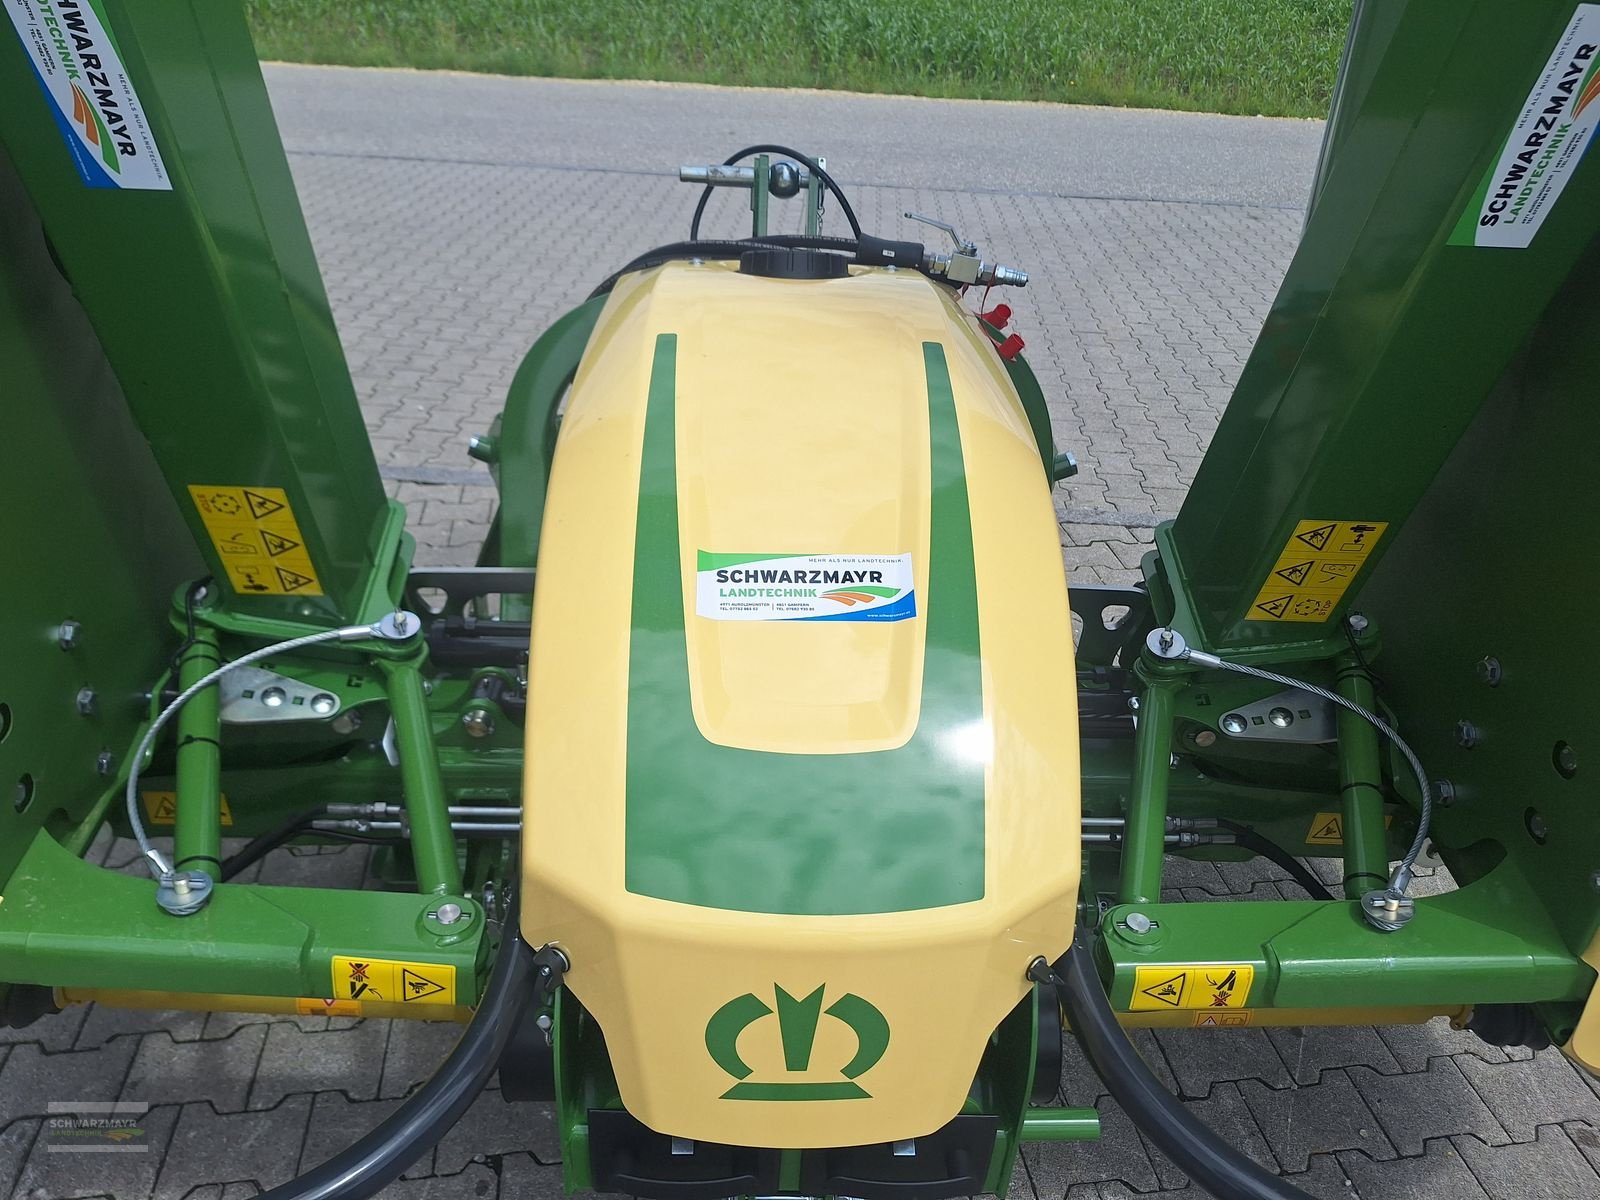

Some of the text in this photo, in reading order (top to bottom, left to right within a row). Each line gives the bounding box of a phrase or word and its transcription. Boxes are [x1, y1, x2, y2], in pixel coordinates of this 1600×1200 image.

[118, 73, 131, 95] MEHR
[127, 97, 137, 112] ALS
[134, 114, 144, 129] NUR
[1531, 92, 1542, 107] ALS
[1540, 73, 1552, 90] NUR
[1480, 43, 1599, 227] SCHWARZMAYR
[1503, 123, 1572, 225] LANDTECHNIK
[716, 569, 883, 584] SCHWARZMAYR
[719, 588, 817, 598] LANDTECHNIK
[1318, 600, 1332, 616] STOP
